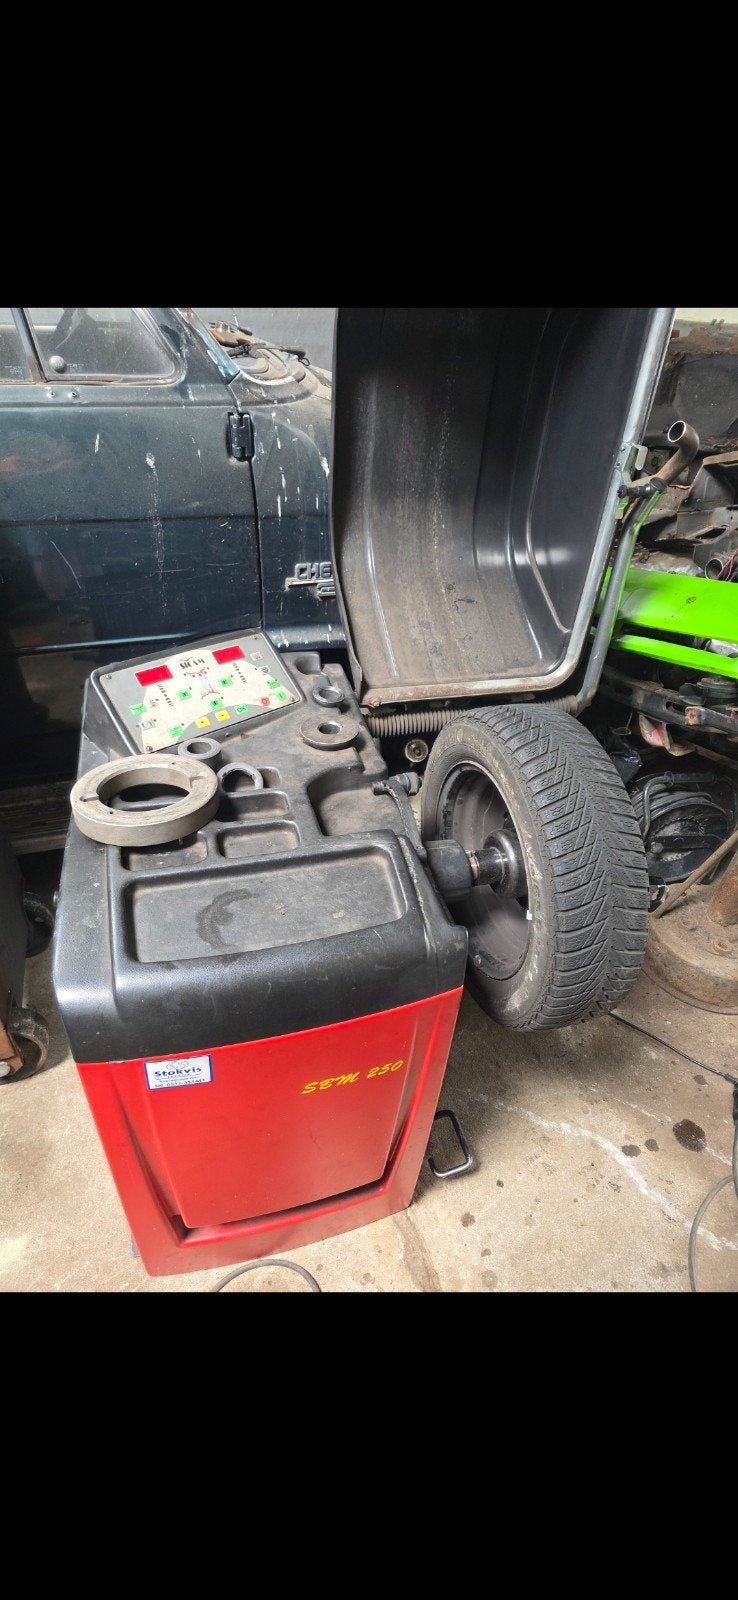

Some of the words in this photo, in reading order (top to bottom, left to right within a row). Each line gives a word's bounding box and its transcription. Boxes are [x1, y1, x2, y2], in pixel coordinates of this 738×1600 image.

[154, 1066, 202, 1078] Stokvis
[301, 1072, 360, 1094] SBM
[367, 1060, 403, 1079] 250
